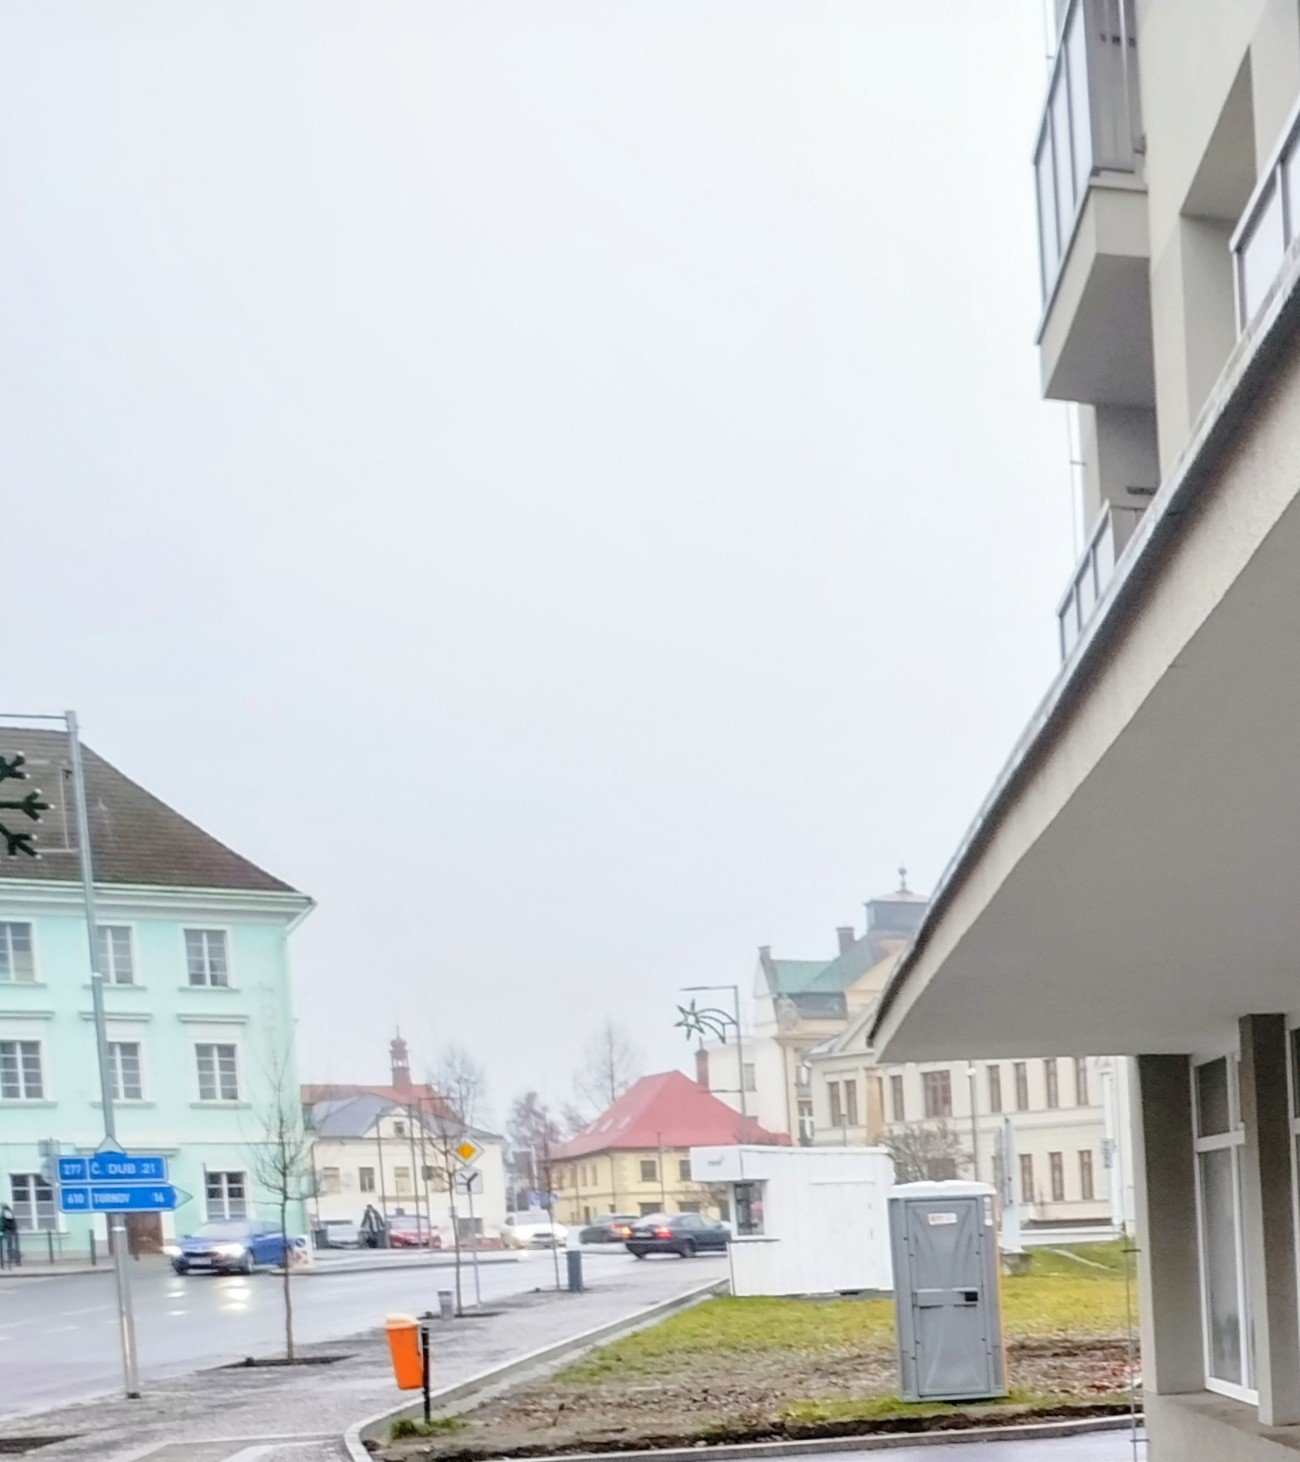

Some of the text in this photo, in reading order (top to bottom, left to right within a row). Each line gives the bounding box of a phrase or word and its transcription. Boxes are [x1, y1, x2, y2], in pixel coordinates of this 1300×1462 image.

[107, 1163, 136, 1175] DUB
[142, 1163, 155, 1174] 21
[94, 1193, 130, 1204] TURNOV
